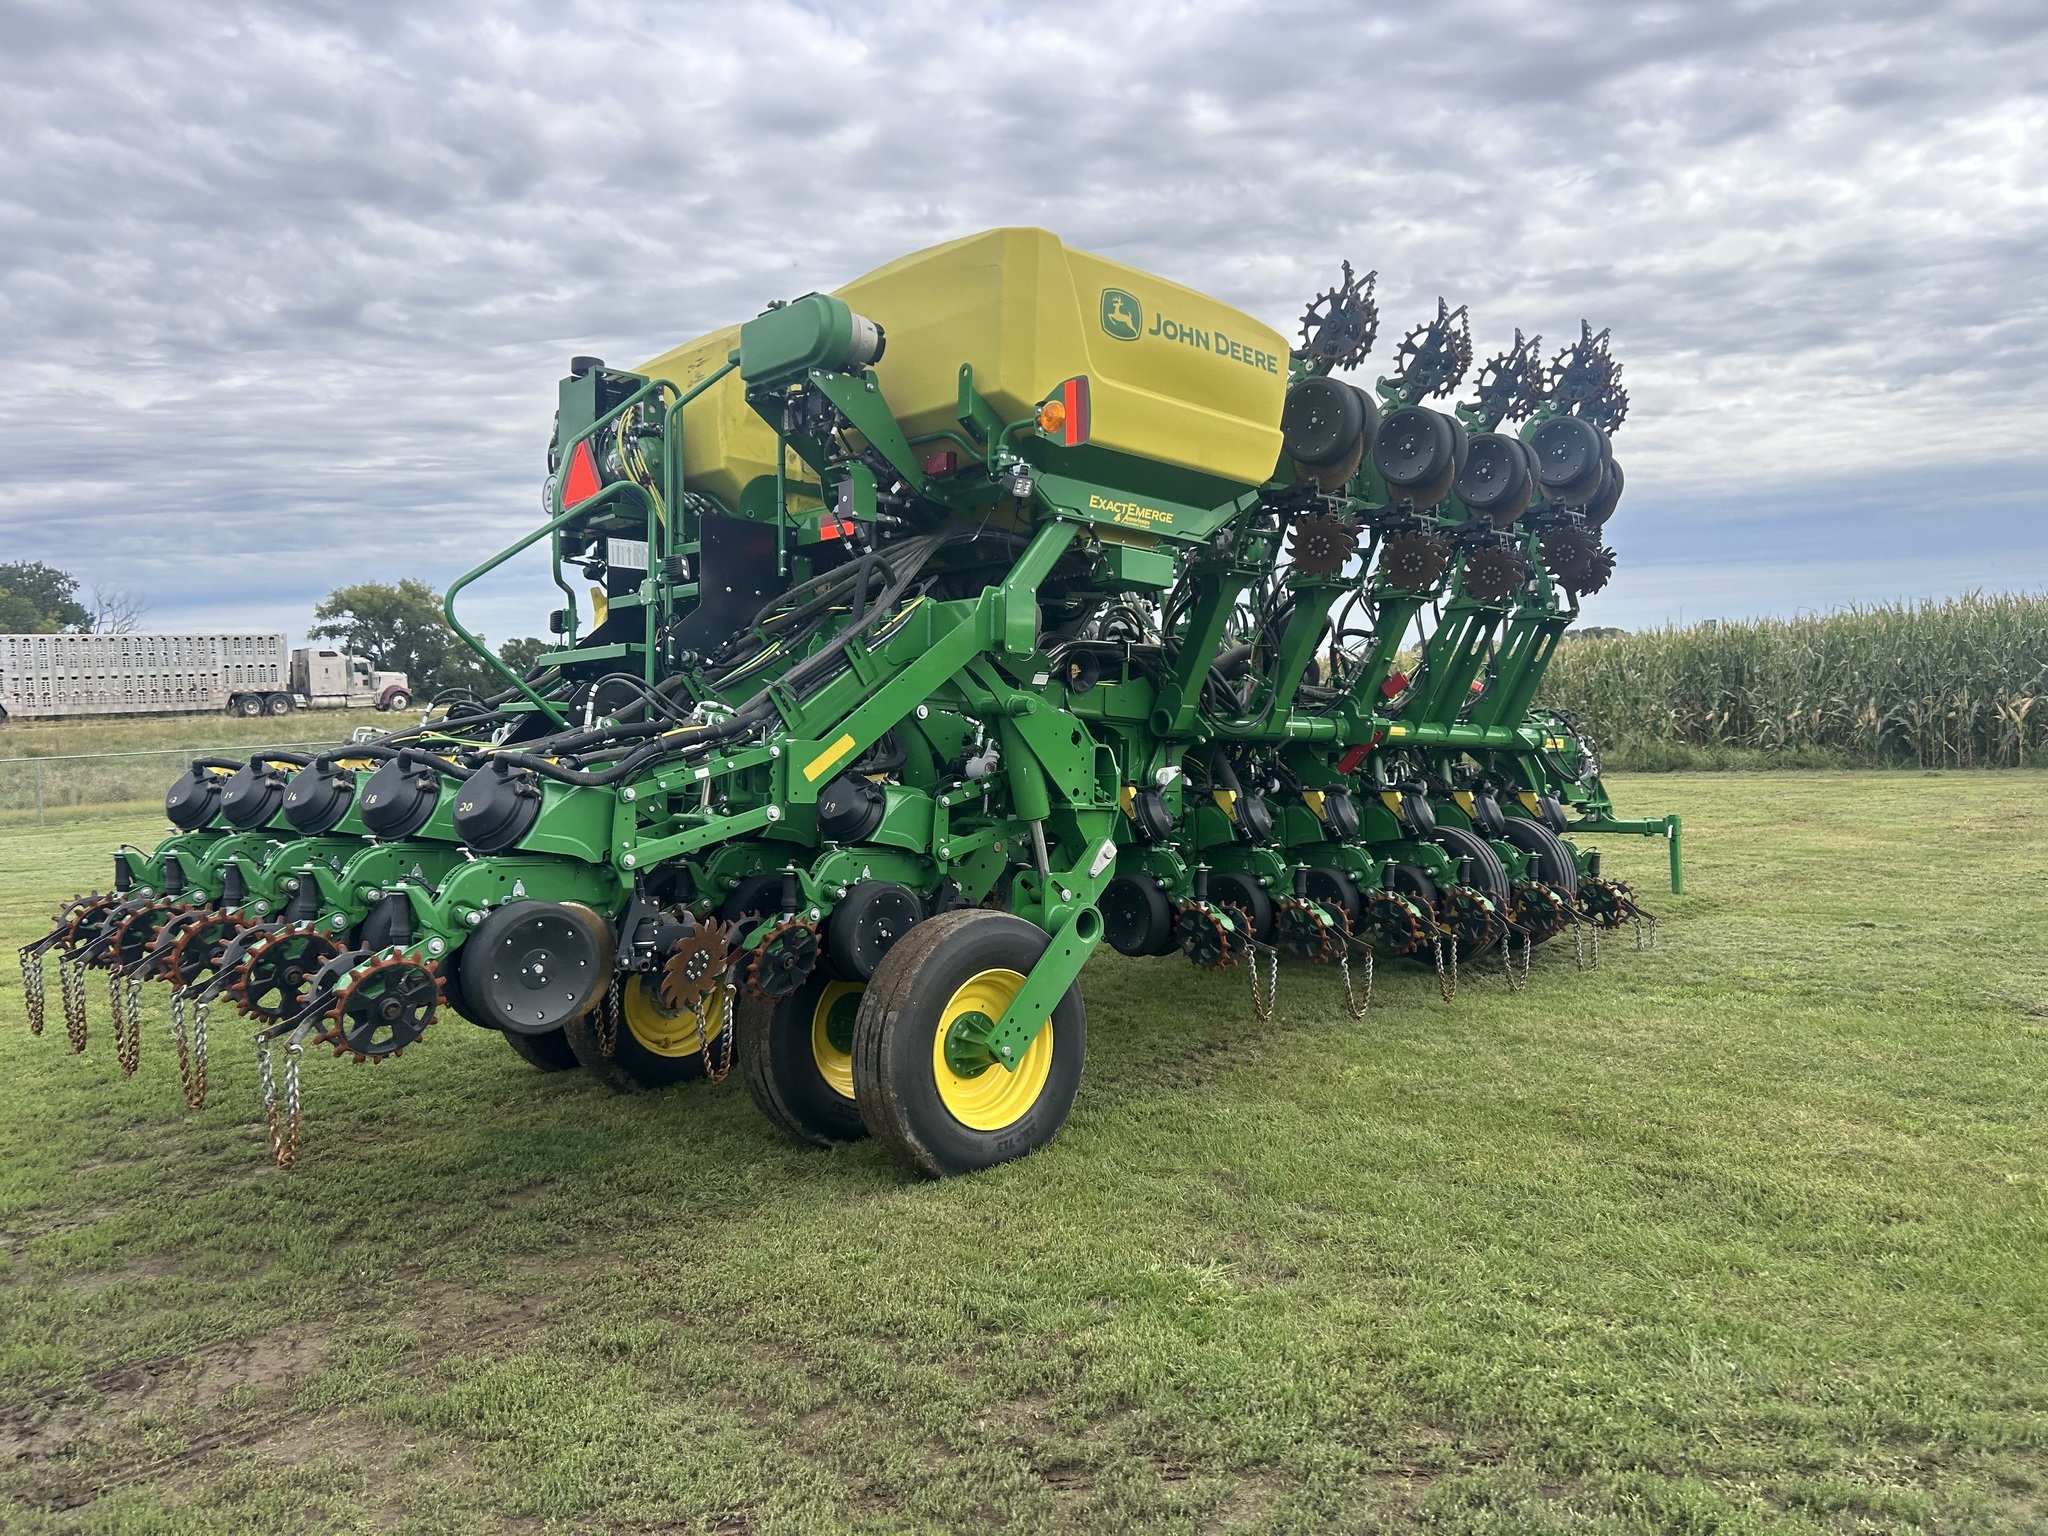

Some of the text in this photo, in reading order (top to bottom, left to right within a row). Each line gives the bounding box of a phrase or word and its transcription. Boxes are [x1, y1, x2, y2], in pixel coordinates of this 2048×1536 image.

[1149, 313, 1278, 375] JOHN DEERE
[287, 792, 297, 801] 16
[365, 794, 378, 804] 18
[458, 802, 473, 812] 20
[824, 801, 836, 813] 19
